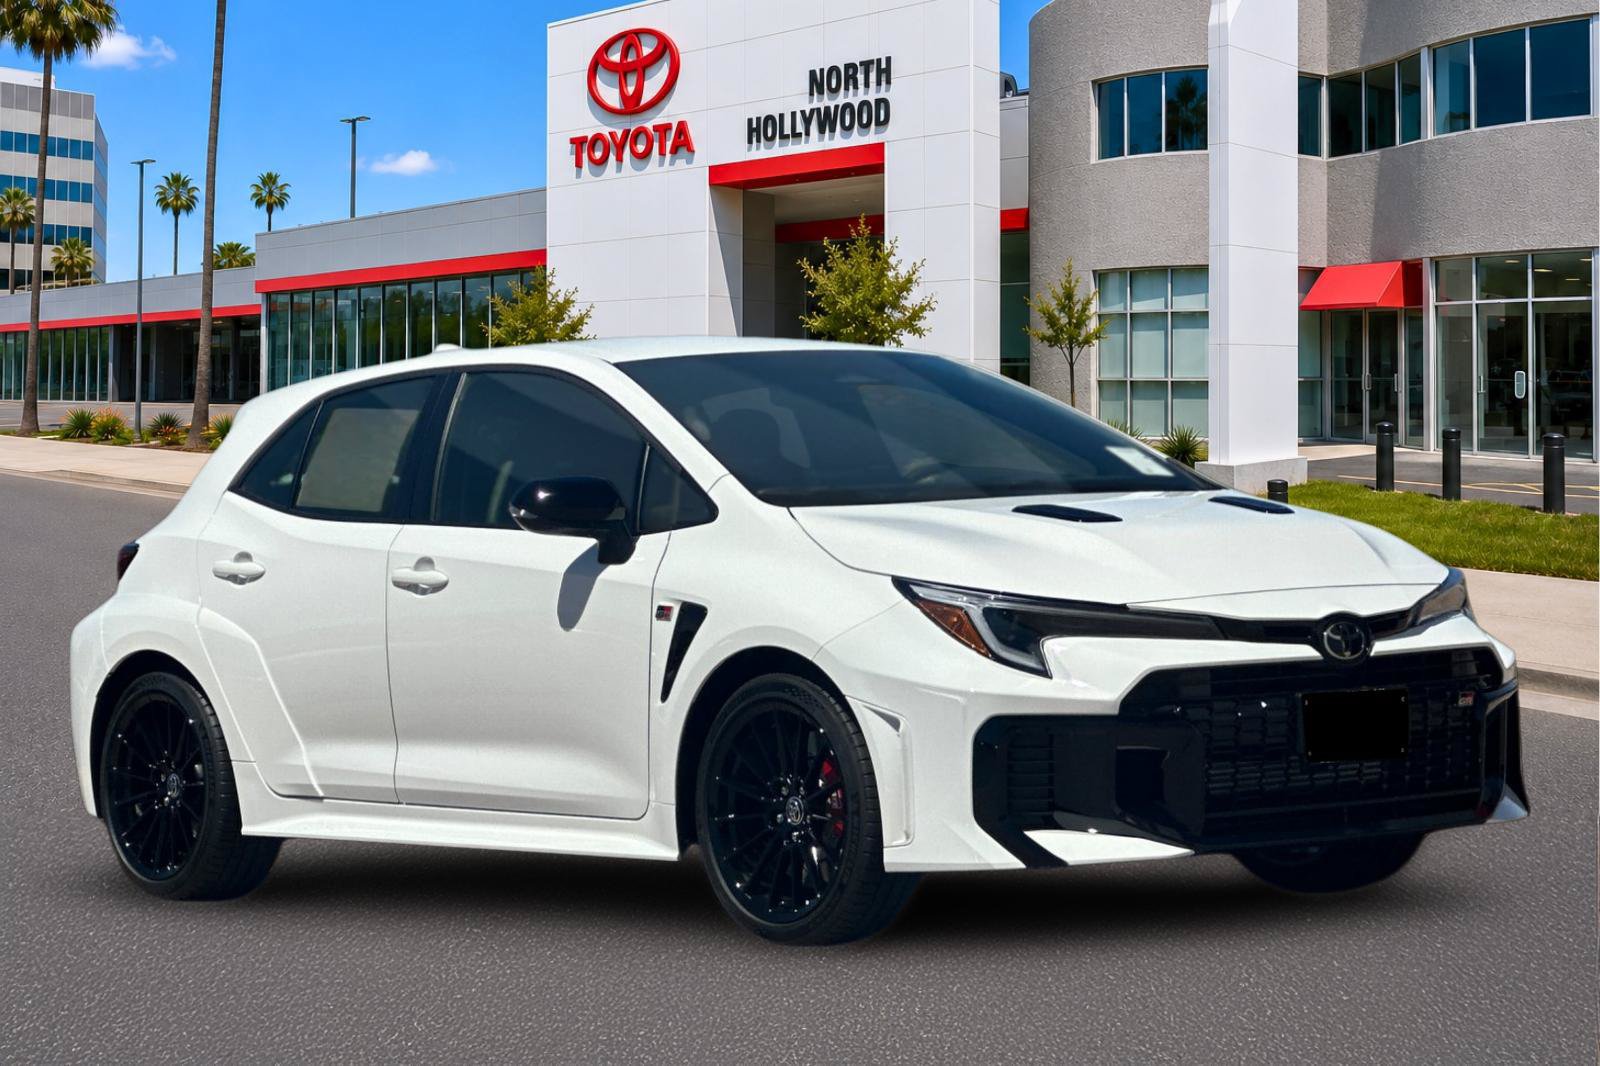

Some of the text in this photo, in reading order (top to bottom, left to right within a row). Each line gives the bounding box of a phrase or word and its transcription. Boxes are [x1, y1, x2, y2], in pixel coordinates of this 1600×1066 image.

[808, 56, 892, 97] NORTH
[569, 120, 695, 169] TOYOTA
[747, 97, 891, 145] HOLLYWOOD
